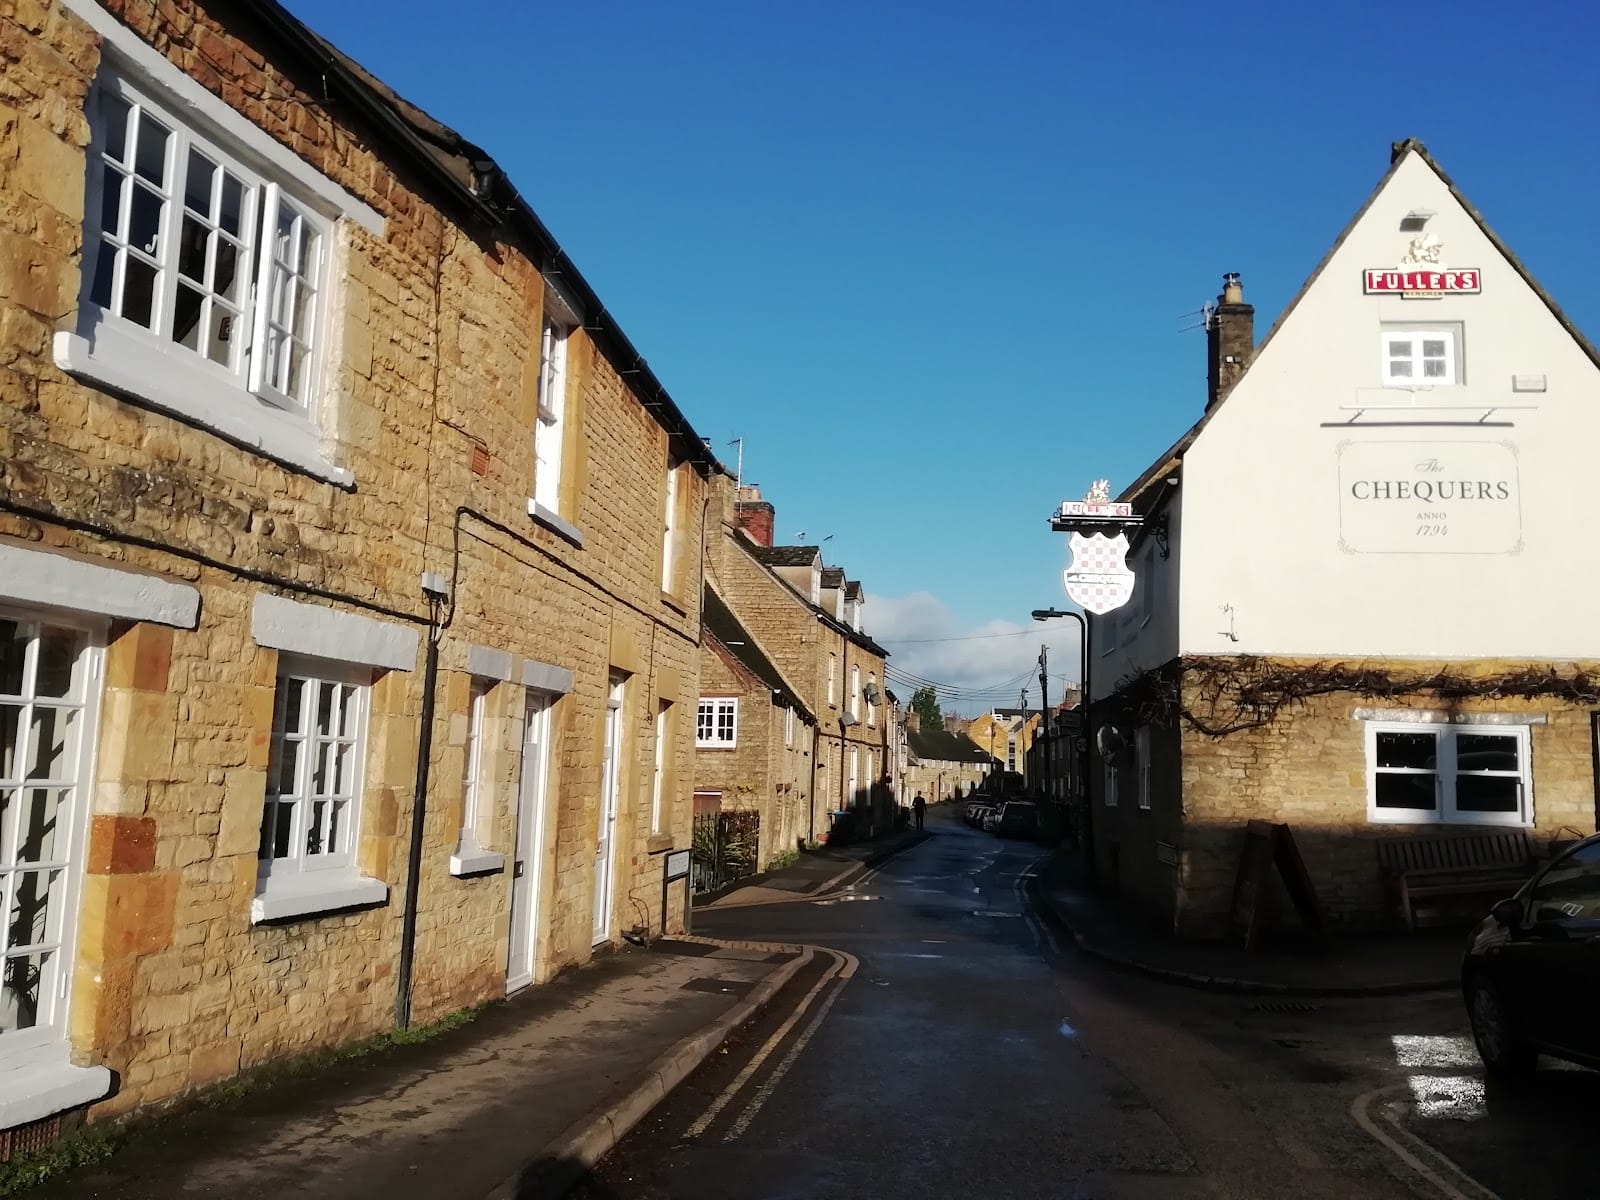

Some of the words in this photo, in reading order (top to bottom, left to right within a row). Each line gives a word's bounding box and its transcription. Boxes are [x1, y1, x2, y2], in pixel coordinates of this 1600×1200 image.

[1415, 457, 1446, 473] The
[1352, 480, 1509, 504] CHEQUERS
[1416, 512, 1447, 521] ANNO
[1416, 525, 1448, 537] 1794
